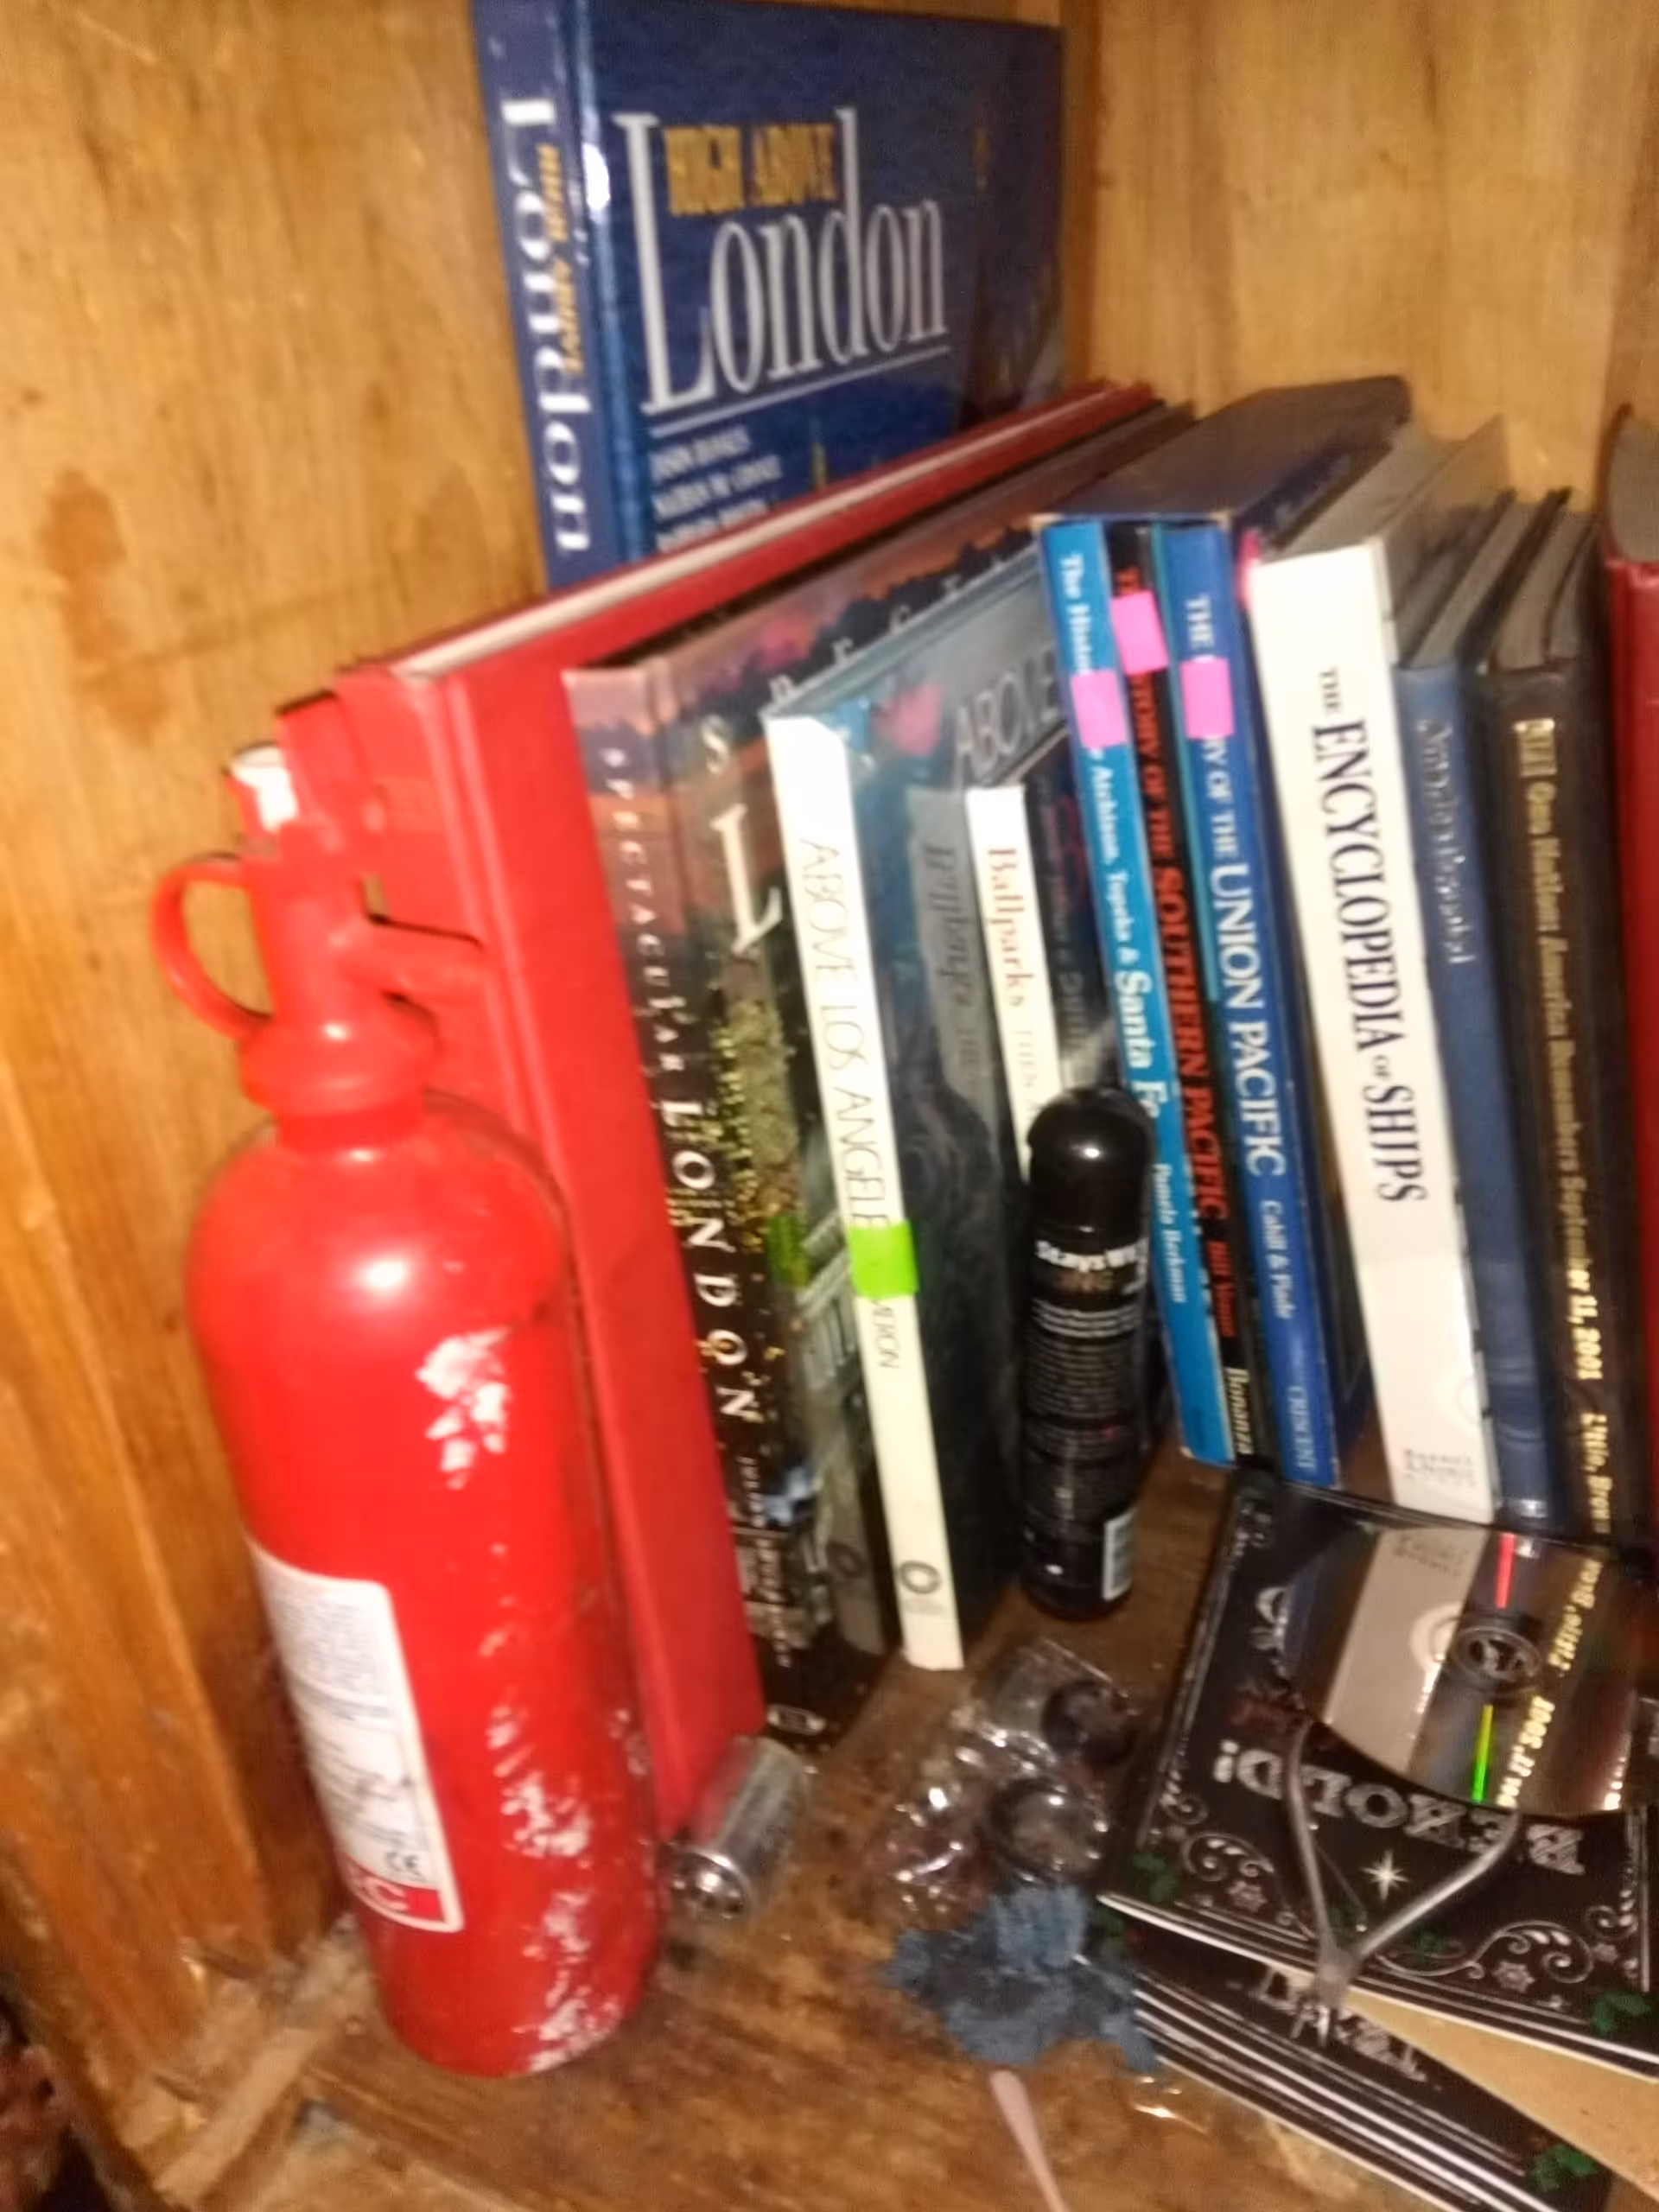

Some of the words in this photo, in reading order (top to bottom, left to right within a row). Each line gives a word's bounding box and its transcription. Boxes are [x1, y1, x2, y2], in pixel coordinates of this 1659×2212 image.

[613, 107, 950, 417] London
[501, 99, 591, 552] London
[1060, 553, 1084, 599] The
[1067, 603, 1094, 675] Histor
[1185, 594, 1216, 650] THE
[1319, 668, 1343, 715] THE
[1090, 766, 1120, 866] Atchison,
[1205, 770, 1233, 804] OF
[1147, 807, 1173, 860] THE
[1210, 810, 1239, 860] THE
[798, 835, 859, 979] ABOVE
[1105, 868, 1135, 942] Topeka
[1312, 720, 1407, 1052] ENCYCLOPEDIA
[987, 848, 1034, 1007] Ballparks
[1116, 946, 1141, 966] &
[1210, 862, 1266, 1010] UNION
[1152, 866, 1210, 1077] SOUTHERN
[817, 1003, 868, 1071] LOS
[1114, 969, 1156, 1069] Santa
[1227, 1020, 1287, 1178] PACIFIC
[831, 1086, 892, 1229] ANGELE
[1181, 1085, 1229, 1220] PACIFIC
[1362, 1084, 1428, 1205] SHIPS
[1152, 1163, 1178, 1225] Pamela
[1258, 1199, 1289, 1251] Cahill
[660, 1098, 763, 1421] LONDON
[1161, 1230, 1188, 1304] Berkman
[1265, 1252, 1290, 1271] &
[1559, 1175, 1592, 1293] September
[872, 1300, 901, 1370] MERON
[1566, 1294, 1598, 1325] 11,
[1571, 1326, 1604, 1380] 2001
[1224, 1365, 1254, 1456] Bonanza
